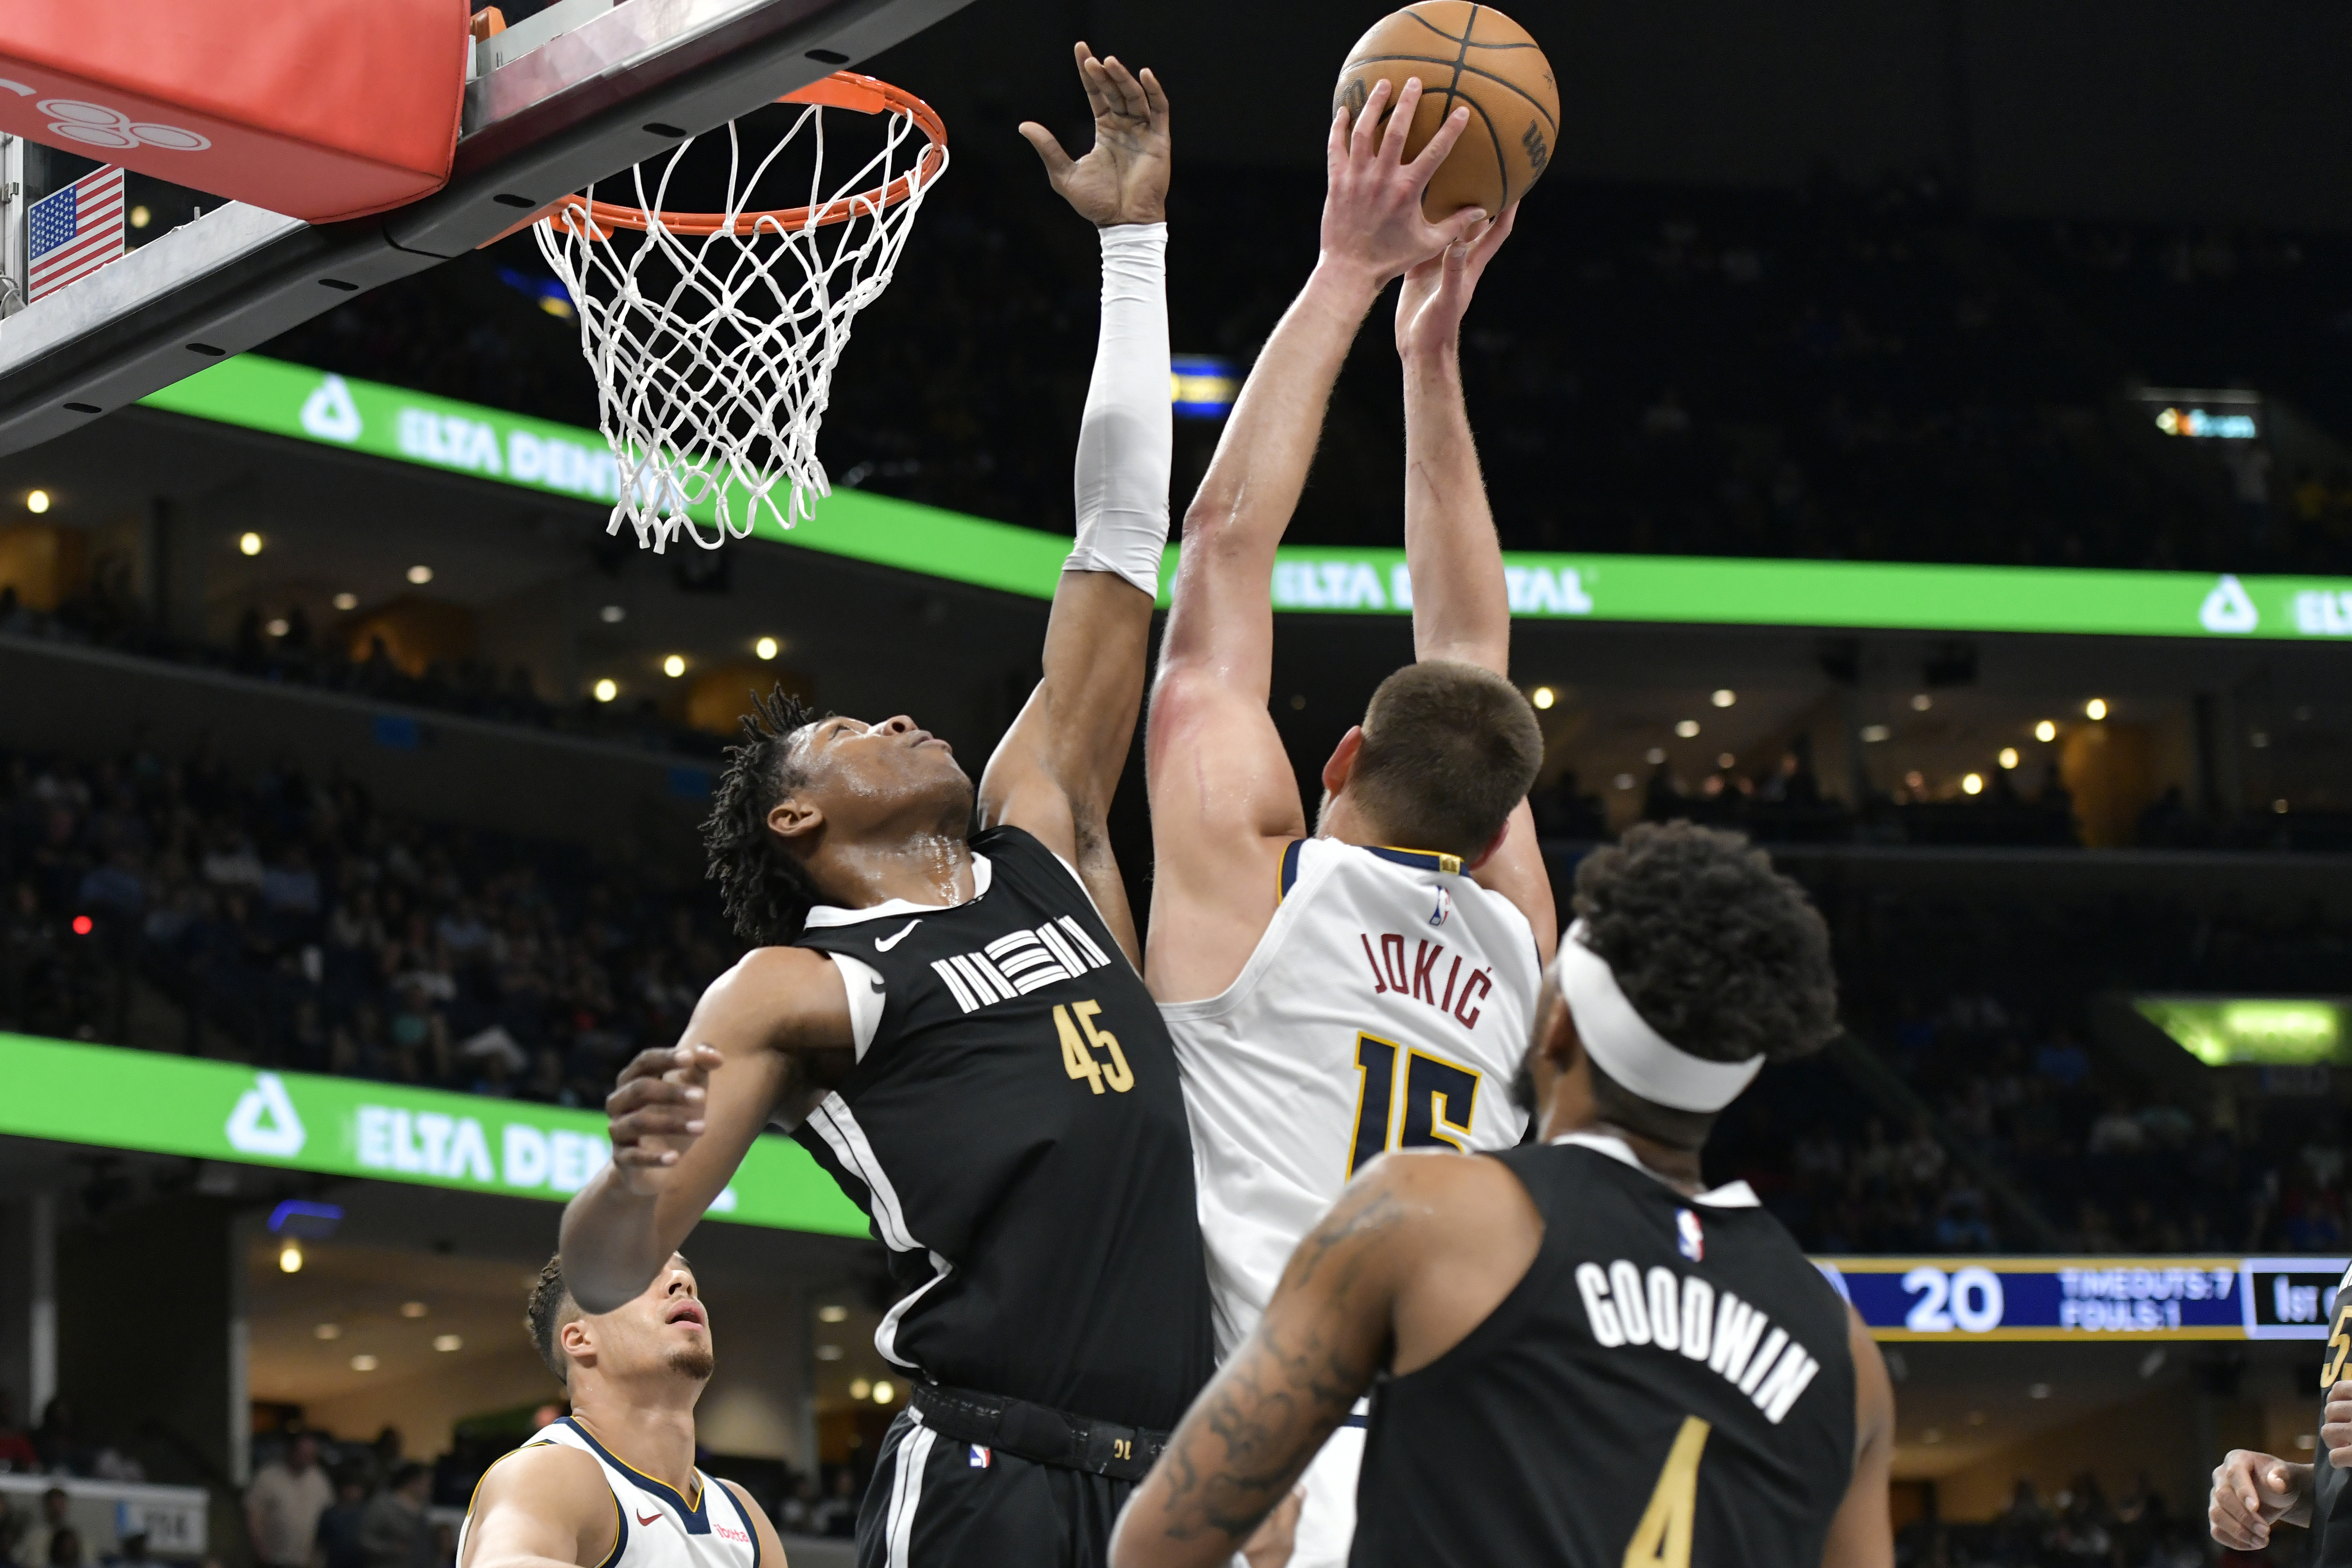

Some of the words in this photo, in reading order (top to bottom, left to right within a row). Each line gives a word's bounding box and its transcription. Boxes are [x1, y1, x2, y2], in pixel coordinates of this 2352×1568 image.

[1361, 933, 1492, 1030] JOKIĆ
[1053, 999, 1134, 1095] 45
[1345, 1030, 1482, 1184] 15
[1575, 1259, 1820, 1424] GOODWIN
[1901, 1265, 2004, 1334] 20
[2320, 1305, 2352, 1388] 5
[1621, 1414, 1712, 1568] 4
